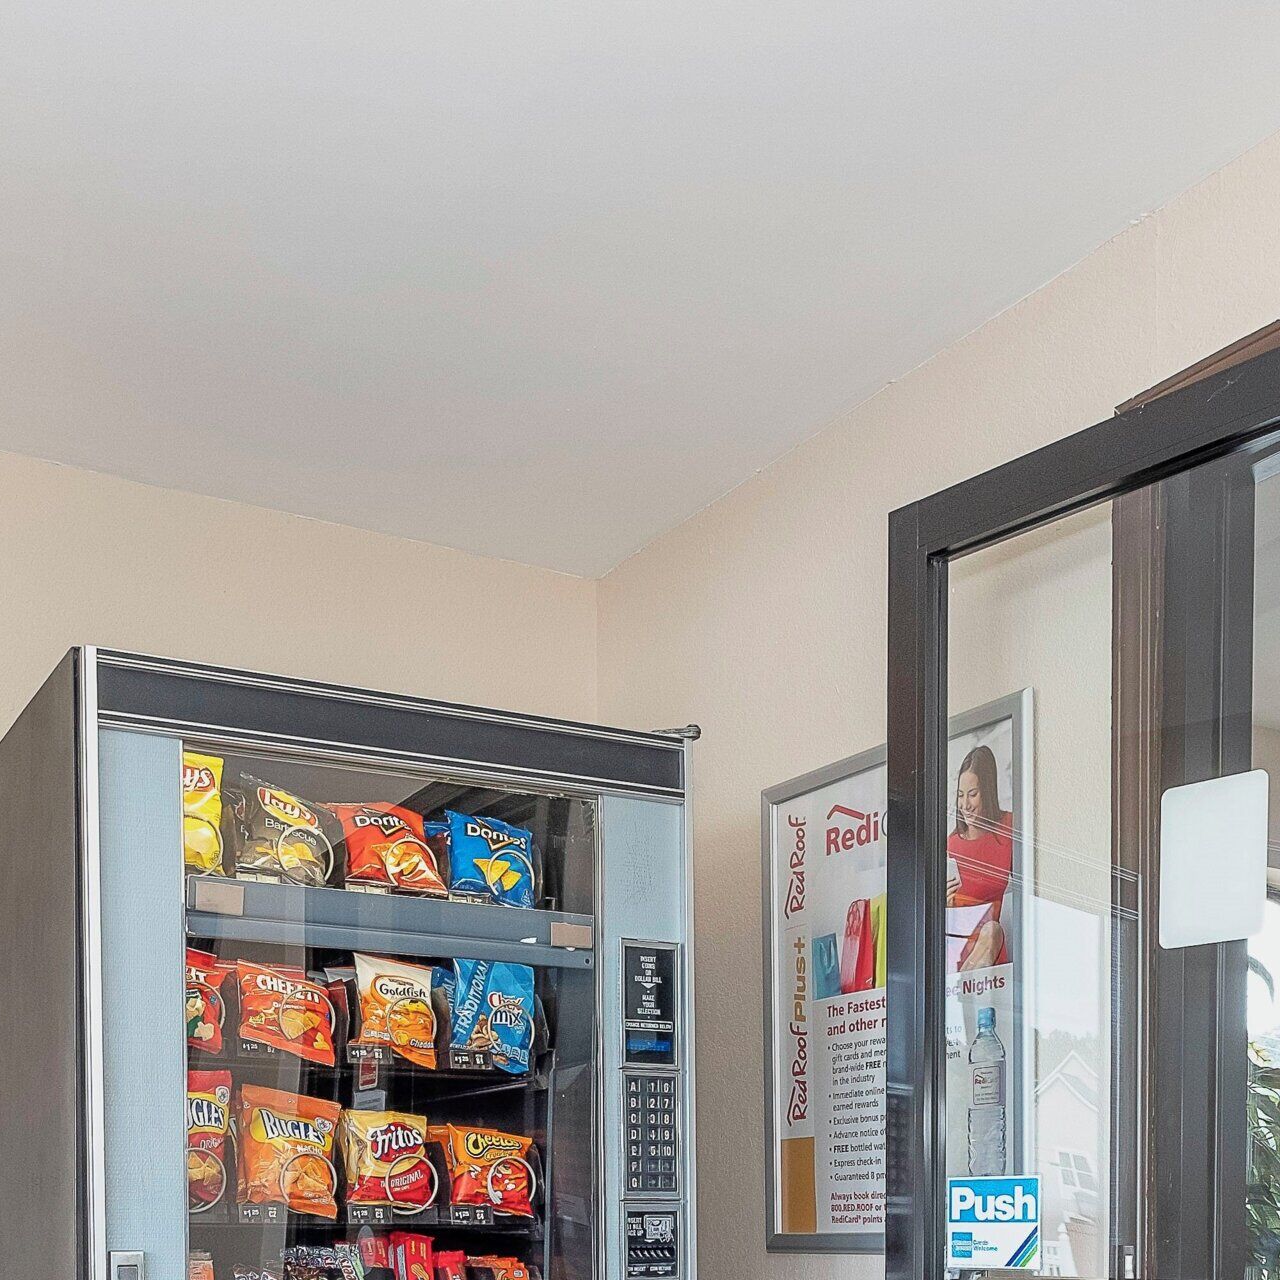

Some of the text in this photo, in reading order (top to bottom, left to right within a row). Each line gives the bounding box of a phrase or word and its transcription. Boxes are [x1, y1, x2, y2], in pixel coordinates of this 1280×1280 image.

[379, 983, 426, 998] Goldfish
[962, 976, 1005, 995] Nights
[453, 960, 490, 1036] TRADITIONAL
[827, 996, 886, 1018] The Fastest
[827, 1020, 846, 1037] and
[848, 1017, 878, 1033] other
[831, 1042, 853, 1052] Choose
[854, 1039, 869, 1051] your
[831, 1053, 843, 1065] gift
[843, 1051, 860, 1062] cards
[860, 1050, 873, 1059] and
[832, 1060, 882, 1075] brand-wide FREE
[832, 1073, 876, 1086] in the industry
[630, 1082, 637, 1092] A
[832, 1086, 886, 1100] Immediate online
[630, 1097, 637, 1108] B
[832, 1098, 880, 1112] earned rewards
[833, 1113, 879, 1126] Exclusive bonus
[260, 1109, 325, 1147] BUGLES
[833, 1130, 859, 1139] Advance
[859, 1128, 879, 1137] notice
[366, 1124, 424, 1159] Fritos
[630, 1130, 637, 1140] D
[466, 1131, 522, 1158] Cheetos
[663, 1146, 672, 1156] 10
[833, 1144, 850, 1154] FREE
[850, 1142, 873, 1153] bottled
[833, 1156, 882, 1169] Express check-in
[834, 1171, 870, 1182] Guaranteed
[831, 1192, 853, 1202] Always
[853, 1191, 870, 1200] book
[951, 1185, 1037, 1221] Push
[862, 1214, 883, 1224] points
